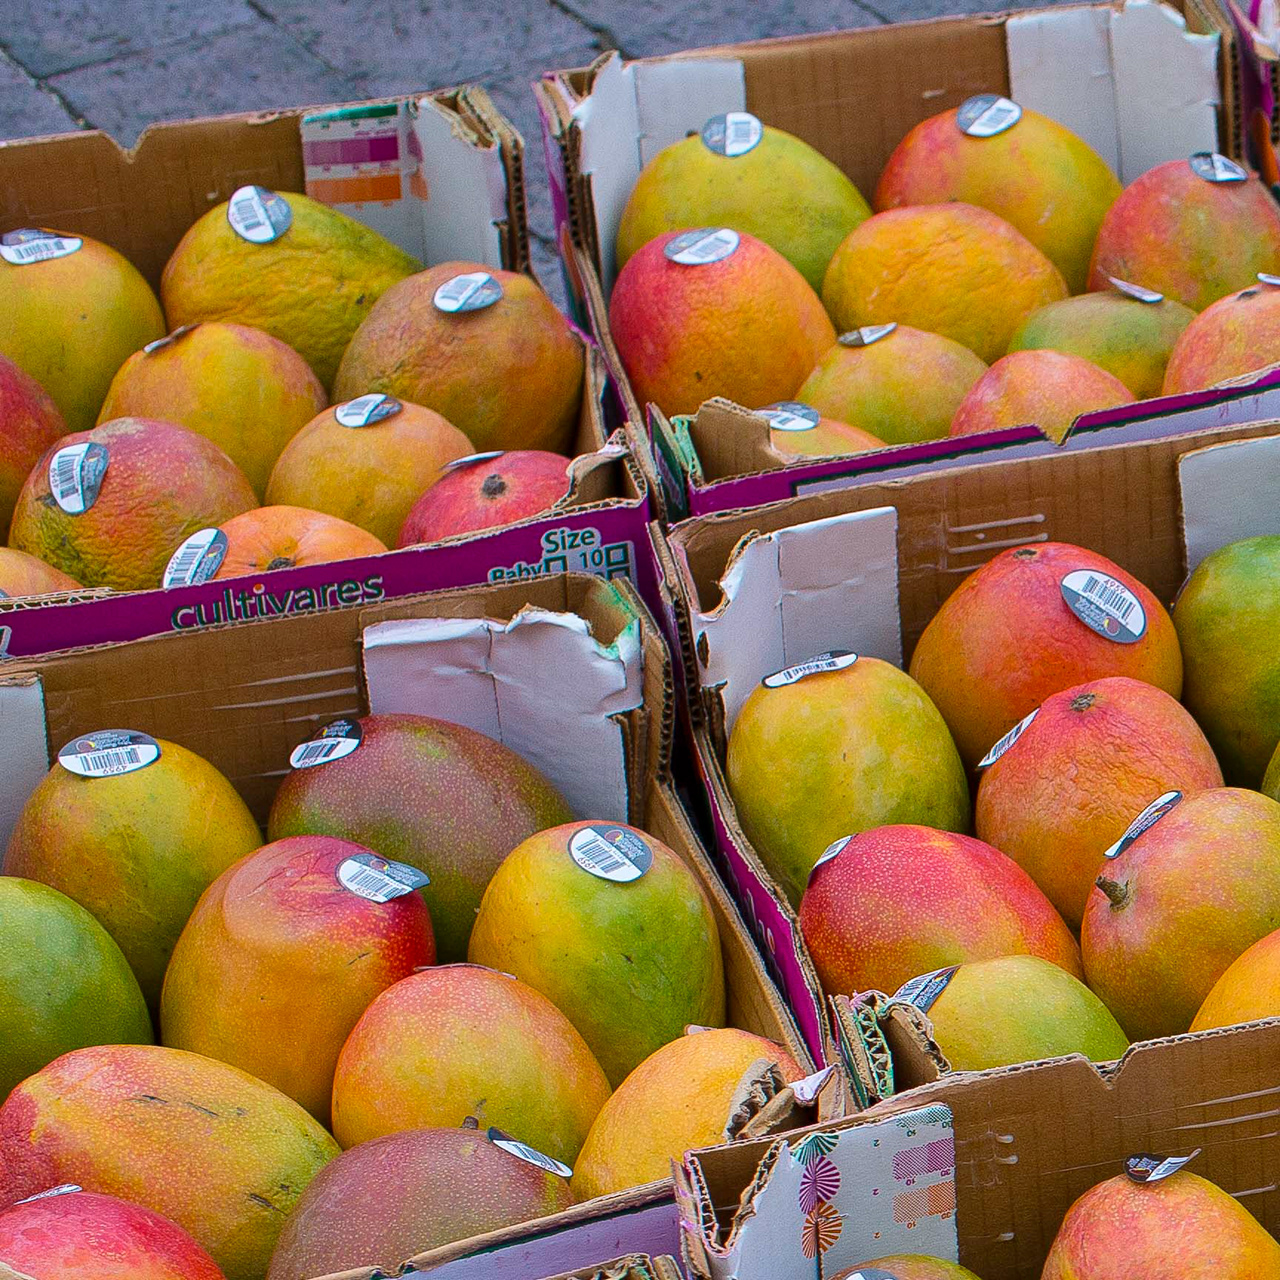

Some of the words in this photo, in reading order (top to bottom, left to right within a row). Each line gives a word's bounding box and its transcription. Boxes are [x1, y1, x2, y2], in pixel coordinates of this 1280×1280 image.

[545, 530, 596, 554] Size
[580, 549, 603, 567] 10
[173, 575, 383, 630] cultivares
[577, 857, 595, 871] 4959
